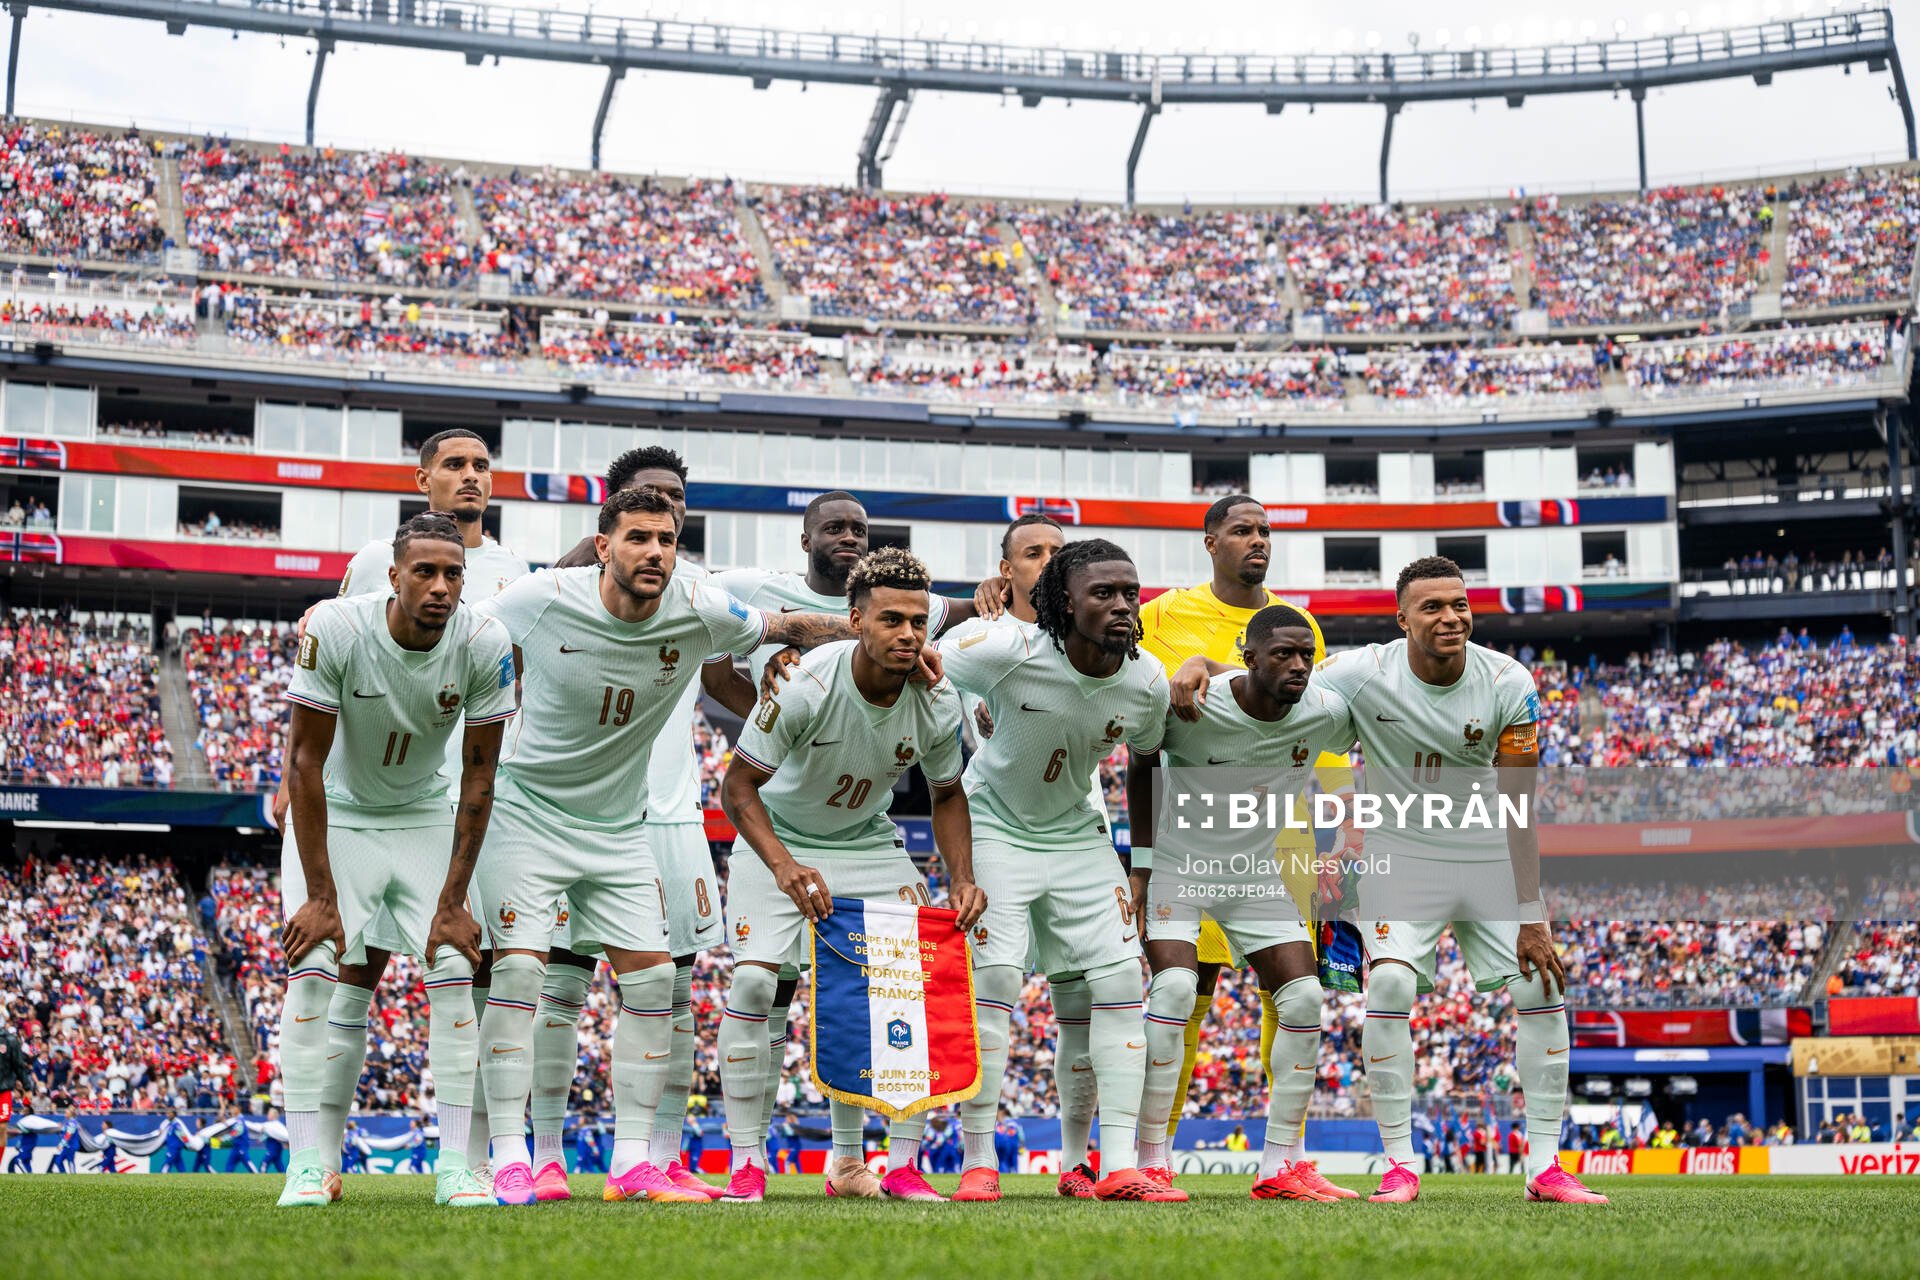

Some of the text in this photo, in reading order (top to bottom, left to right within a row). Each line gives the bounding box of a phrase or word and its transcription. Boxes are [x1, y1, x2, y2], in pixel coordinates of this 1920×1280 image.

[598, 686, 635, 726] 19
[382, 731, 412, 767] 11
[1043, 748, 1067, 783] 6
[1412, 751, 1442, 783] 10
[826, 774, 872, 809] 20
[695, 878, 711, 917] 8
[1115, 886, 1132, 925] 6
[848, 932, 938, 951] COUPE DU MONDE
[855, 945, 868, 955] DE
[871, 947, 884, 957] LA
[910, 952, 935, 962] 2026
[861, 965, 932, 982] NORVEGE
[868, 986, 926, 1001] FRANCE
[860, 1069, 940, 1080] 26 JUIN 2026
[877, 1083, 924, 1092] BOSTON
